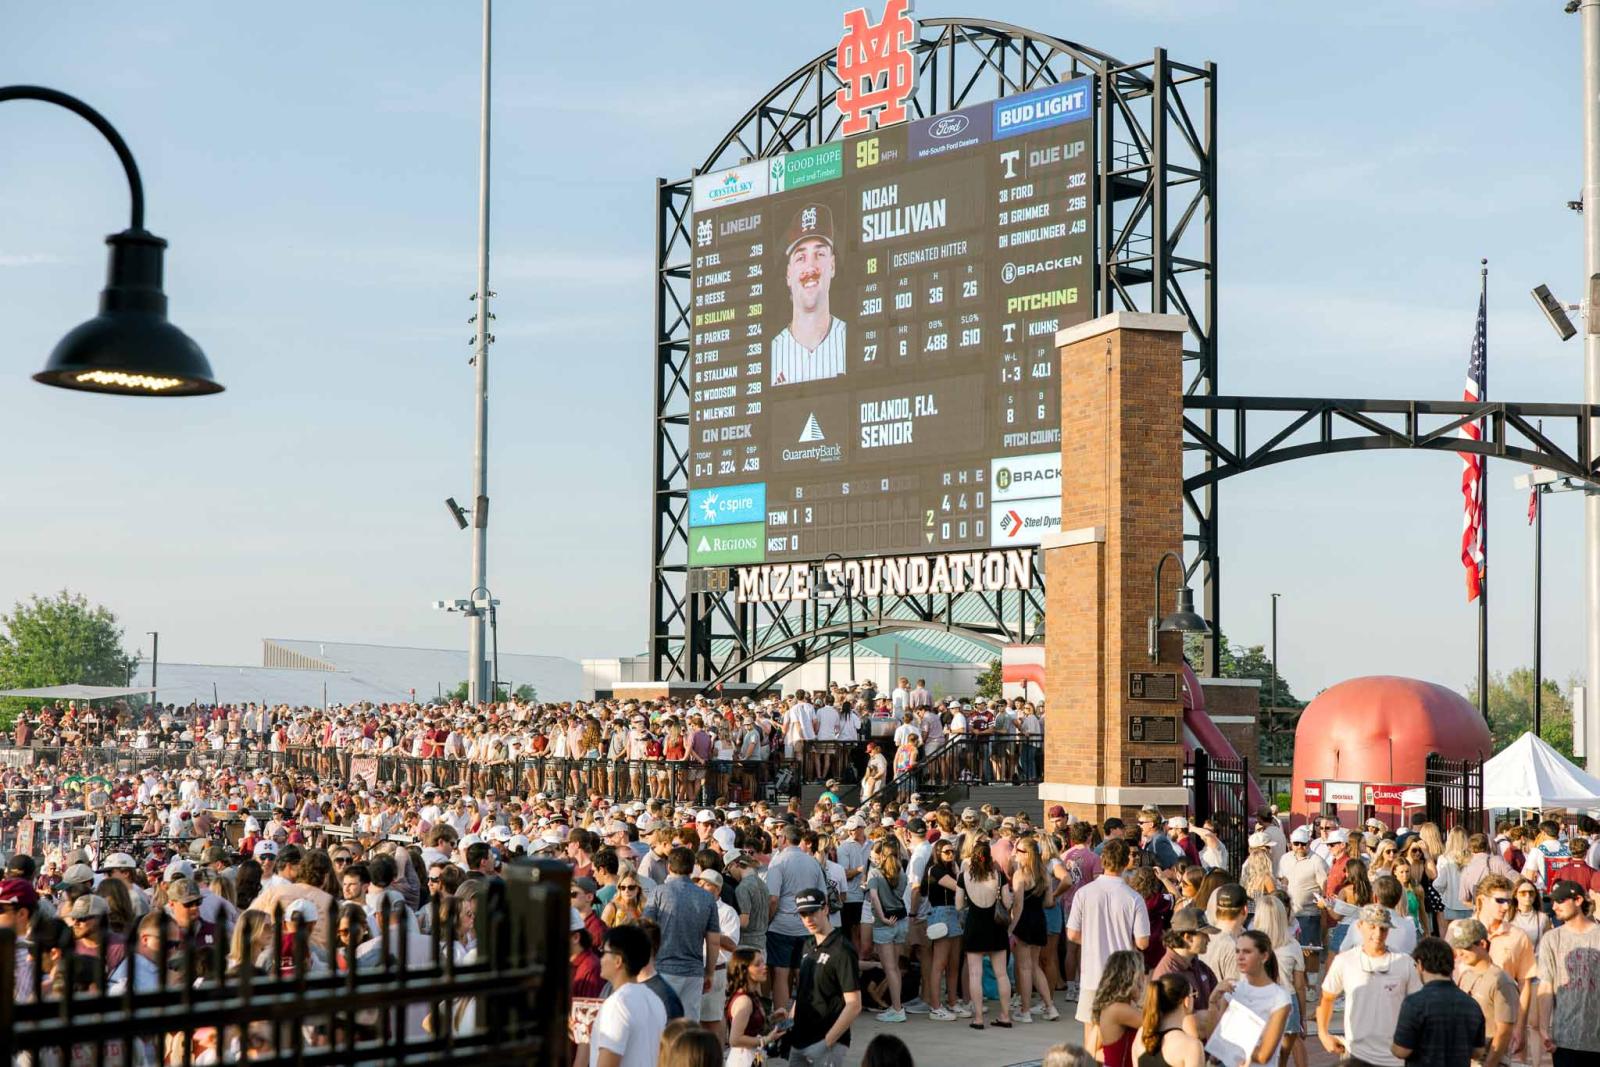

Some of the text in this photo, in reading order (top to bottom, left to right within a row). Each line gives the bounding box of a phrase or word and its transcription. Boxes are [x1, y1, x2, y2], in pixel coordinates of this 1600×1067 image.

[1001, 92, 1084, 127] BUD LIGHT
[936, 117, 962, 136] Ford
[856, 138, 898, 168] 96 MPH
[946, 142, 959, 151] Ford
[787, 149, 841, 172] GOOD HOPE
[1000, 141, 1085, 179] T DUE UP
[709, 181, 753, 198] CRYSTAL SKY
[862, 184, 898, 211] NOAH
[999, 173, 1086, 203] 3B FORD .302
[862, 198, 946, 243] SULLIVAN
[1011, 203, 1050, 223] GRIMMER
[720, 214, 761, 236] LINEUP
[999, 235, 1008, 248] DH
[1011, 223, 1066, 246] GRINDLINGER
[696, 256, 704, 269] CF
[705, 253, 720, 267] TEEL
[866, 241, 967, 274] 18 DESIGNATED HITTER
[1017, 255, 1082, 276] BRACKEN
[705, 270, 732, 286] CHANCE
[899, 278, 908, 286] AB
[933, 272, 939, 280] H
[967, 265, 973, 273] R
[704, 290, 726, 305] REESE
[860, 280, 977, 316] .360 100 36 26
[1007, 287, 1078, 314] PITCHING
[704, 308, 735, 324] SULLIVAN
[865, 330, 876, 340] RBI
[899, 325, 908, 334] HR
[960, 313, 979, 324] SLG%
[1002, 319, 1059, 343] T KUHNS
[704, 329, 730, 344] PARKER
[863, 328, 980, 362] 27 6 .488 .610
[704, 350, 719, 363] FREI
[1038, 349, 1045, 357] IP
[703, 366, 738, 382] STALLMAN
[703, 385, 737, 401] WOODSON
[1008, 395, 1014, 404] S
[703, 405, 736, 421] MILEWSKI
[860, 394, 938, 424] ORLANDO, FLA.
[1006, 404, 1045, 423] 8 6
[702, 424, 752, 443] ON DECK
[861, 421, 913, 448] SENIOR
[1003, 432, 1029, 448] PITCH
[718, 460, 736, 474] .324
[742, 457, 760, 472] .438
[943, 469, 984, 485] R H E
[796, 487, 803, 498] B
[842, 483, 849, 495] S
[768, 492, 984, 527] TENN 1 3 2 4 4 0
[1000, 514, 1012, 531] SDI
[1024, 516, 1043, 528] Steel
[713, 537, 757, 551] REGIONS
[768, 520, 984, 552] MSST 0 0 0 0
[737, 549, 1033, 603] MIZE FOUNDATION
